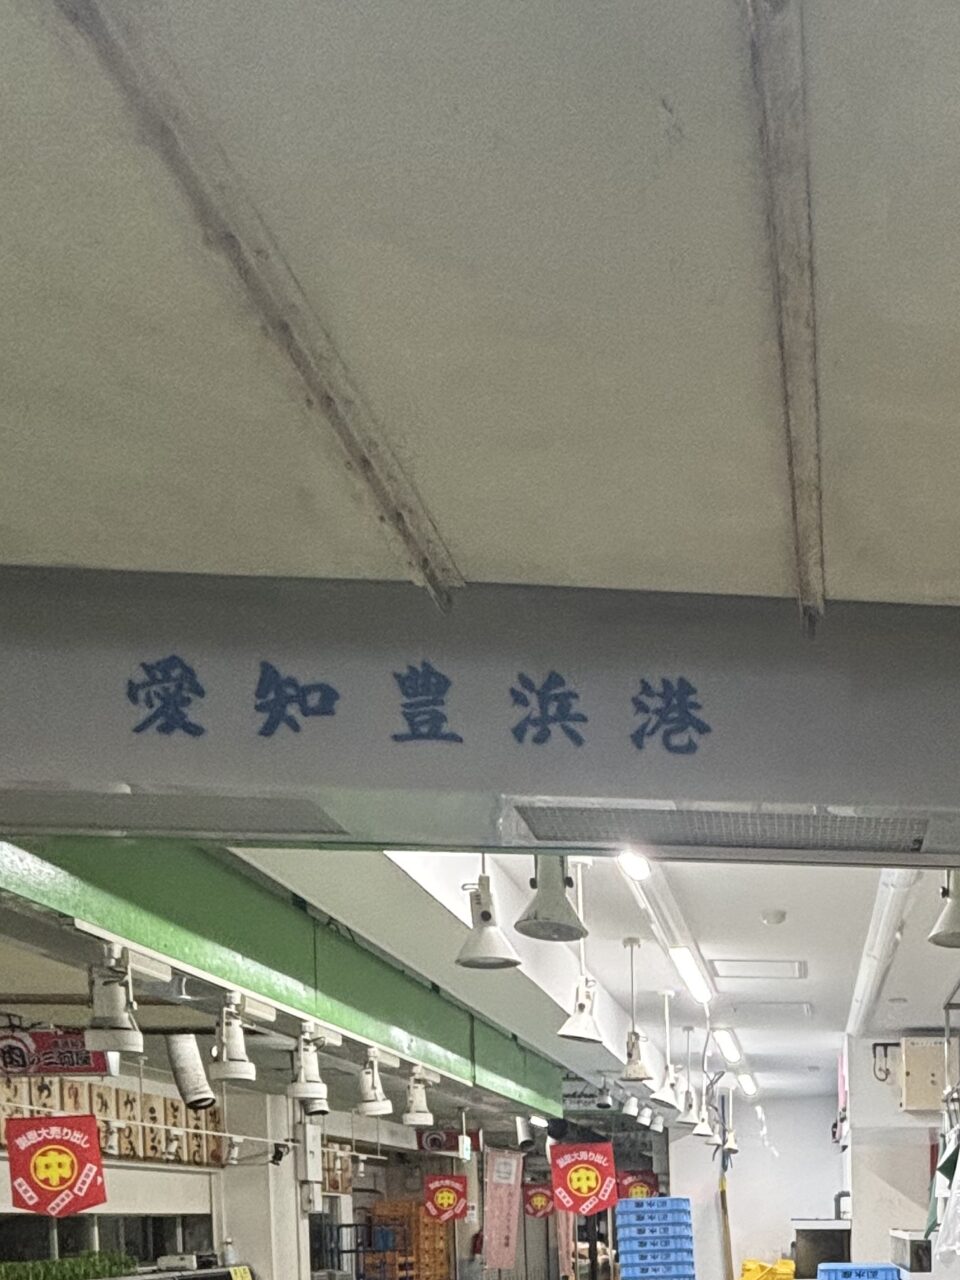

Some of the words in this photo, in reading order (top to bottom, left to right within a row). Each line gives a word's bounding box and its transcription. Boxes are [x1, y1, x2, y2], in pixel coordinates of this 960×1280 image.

[126, 653, 711, 755] 愛知豊浜港
